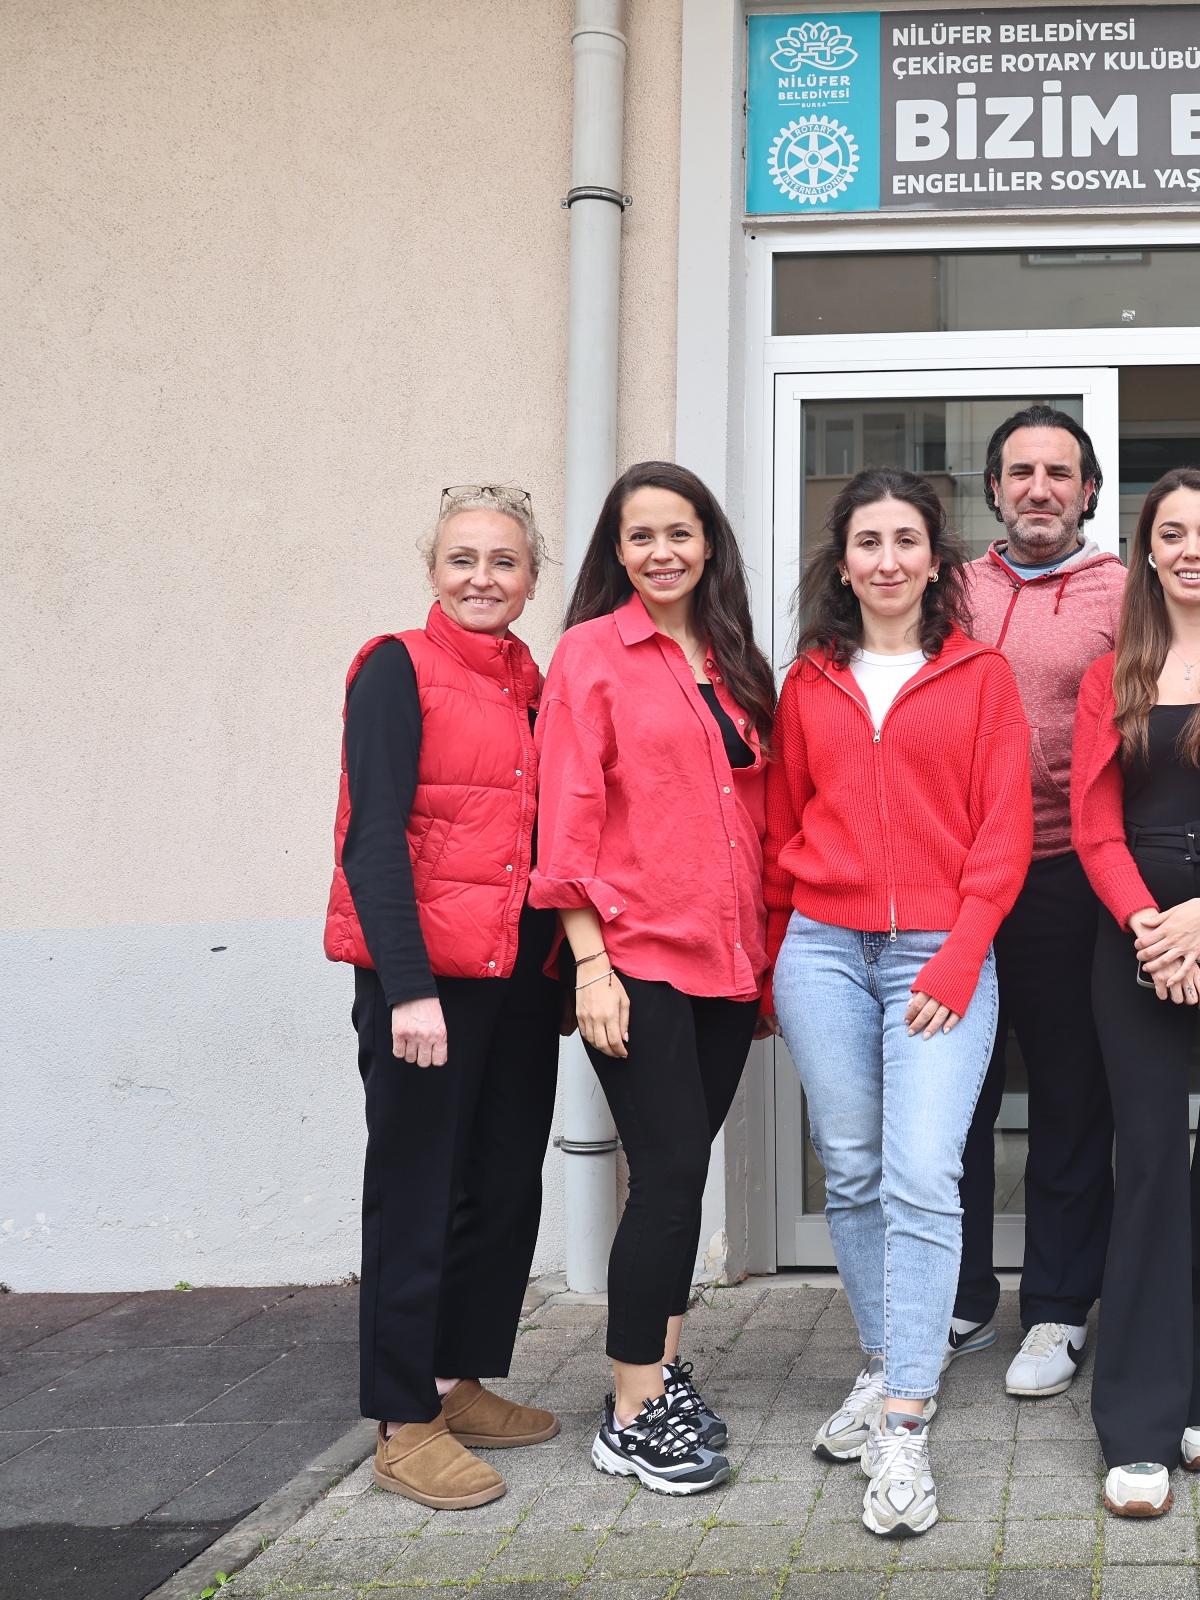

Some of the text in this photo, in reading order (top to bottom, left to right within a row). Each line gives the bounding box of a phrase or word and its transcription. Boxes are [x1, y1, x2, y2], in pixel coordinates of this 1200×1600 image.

[892, 18, 1136, 47] NİLÜFER BELEDİYESİ
[892, 46, 1200, 80] ÇEKİRGE ROTARY KULÜBÜ
[778, 74, 851, 88] NİLÜFER
[778, 87, 850, 101] BELEDİYESİ
[794, 124, 833, 137] ROTARY
[895, 80, 1138, 162] BİZİM
[782, 171, 847, 195] INTERNATIONAL
[892, 167, 1043, 195] ENGELLİLER
[1050, 169, 1147, 191] SOSYAL
